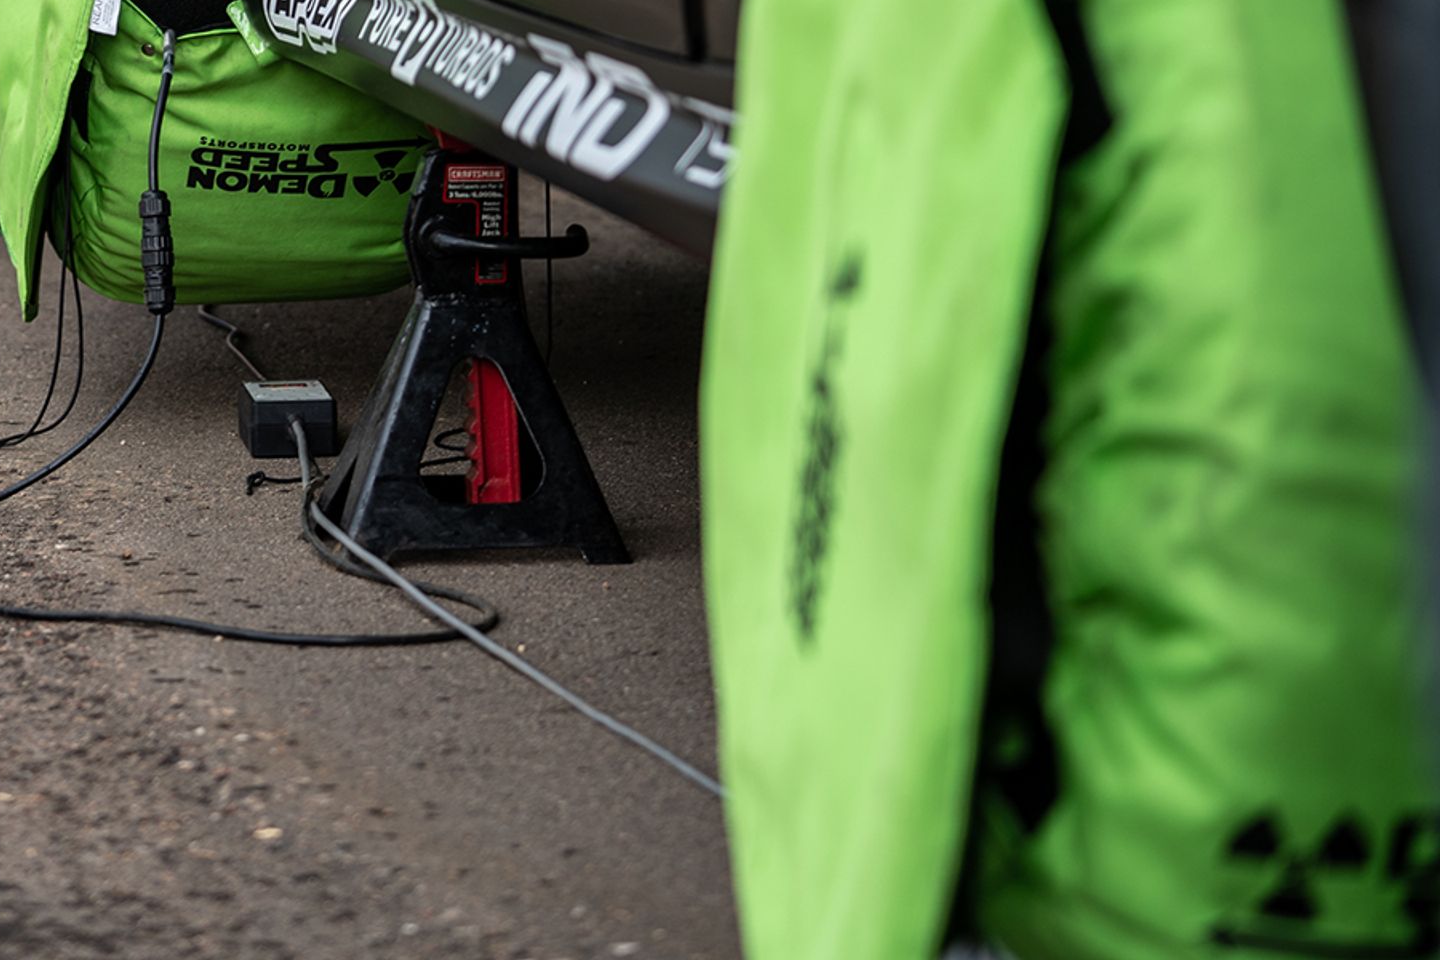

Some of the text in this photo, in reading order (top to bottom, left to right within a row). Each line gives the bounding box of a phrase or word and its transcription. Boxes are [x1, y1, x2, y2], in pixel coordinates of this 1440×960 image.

[426, 12, 516, 100] TURBOS
[191, 144, 340, 173] SPEED
[200, 136, 311, 152] MOTORSPORTS
[186, 166, 348, 199] DEMON
